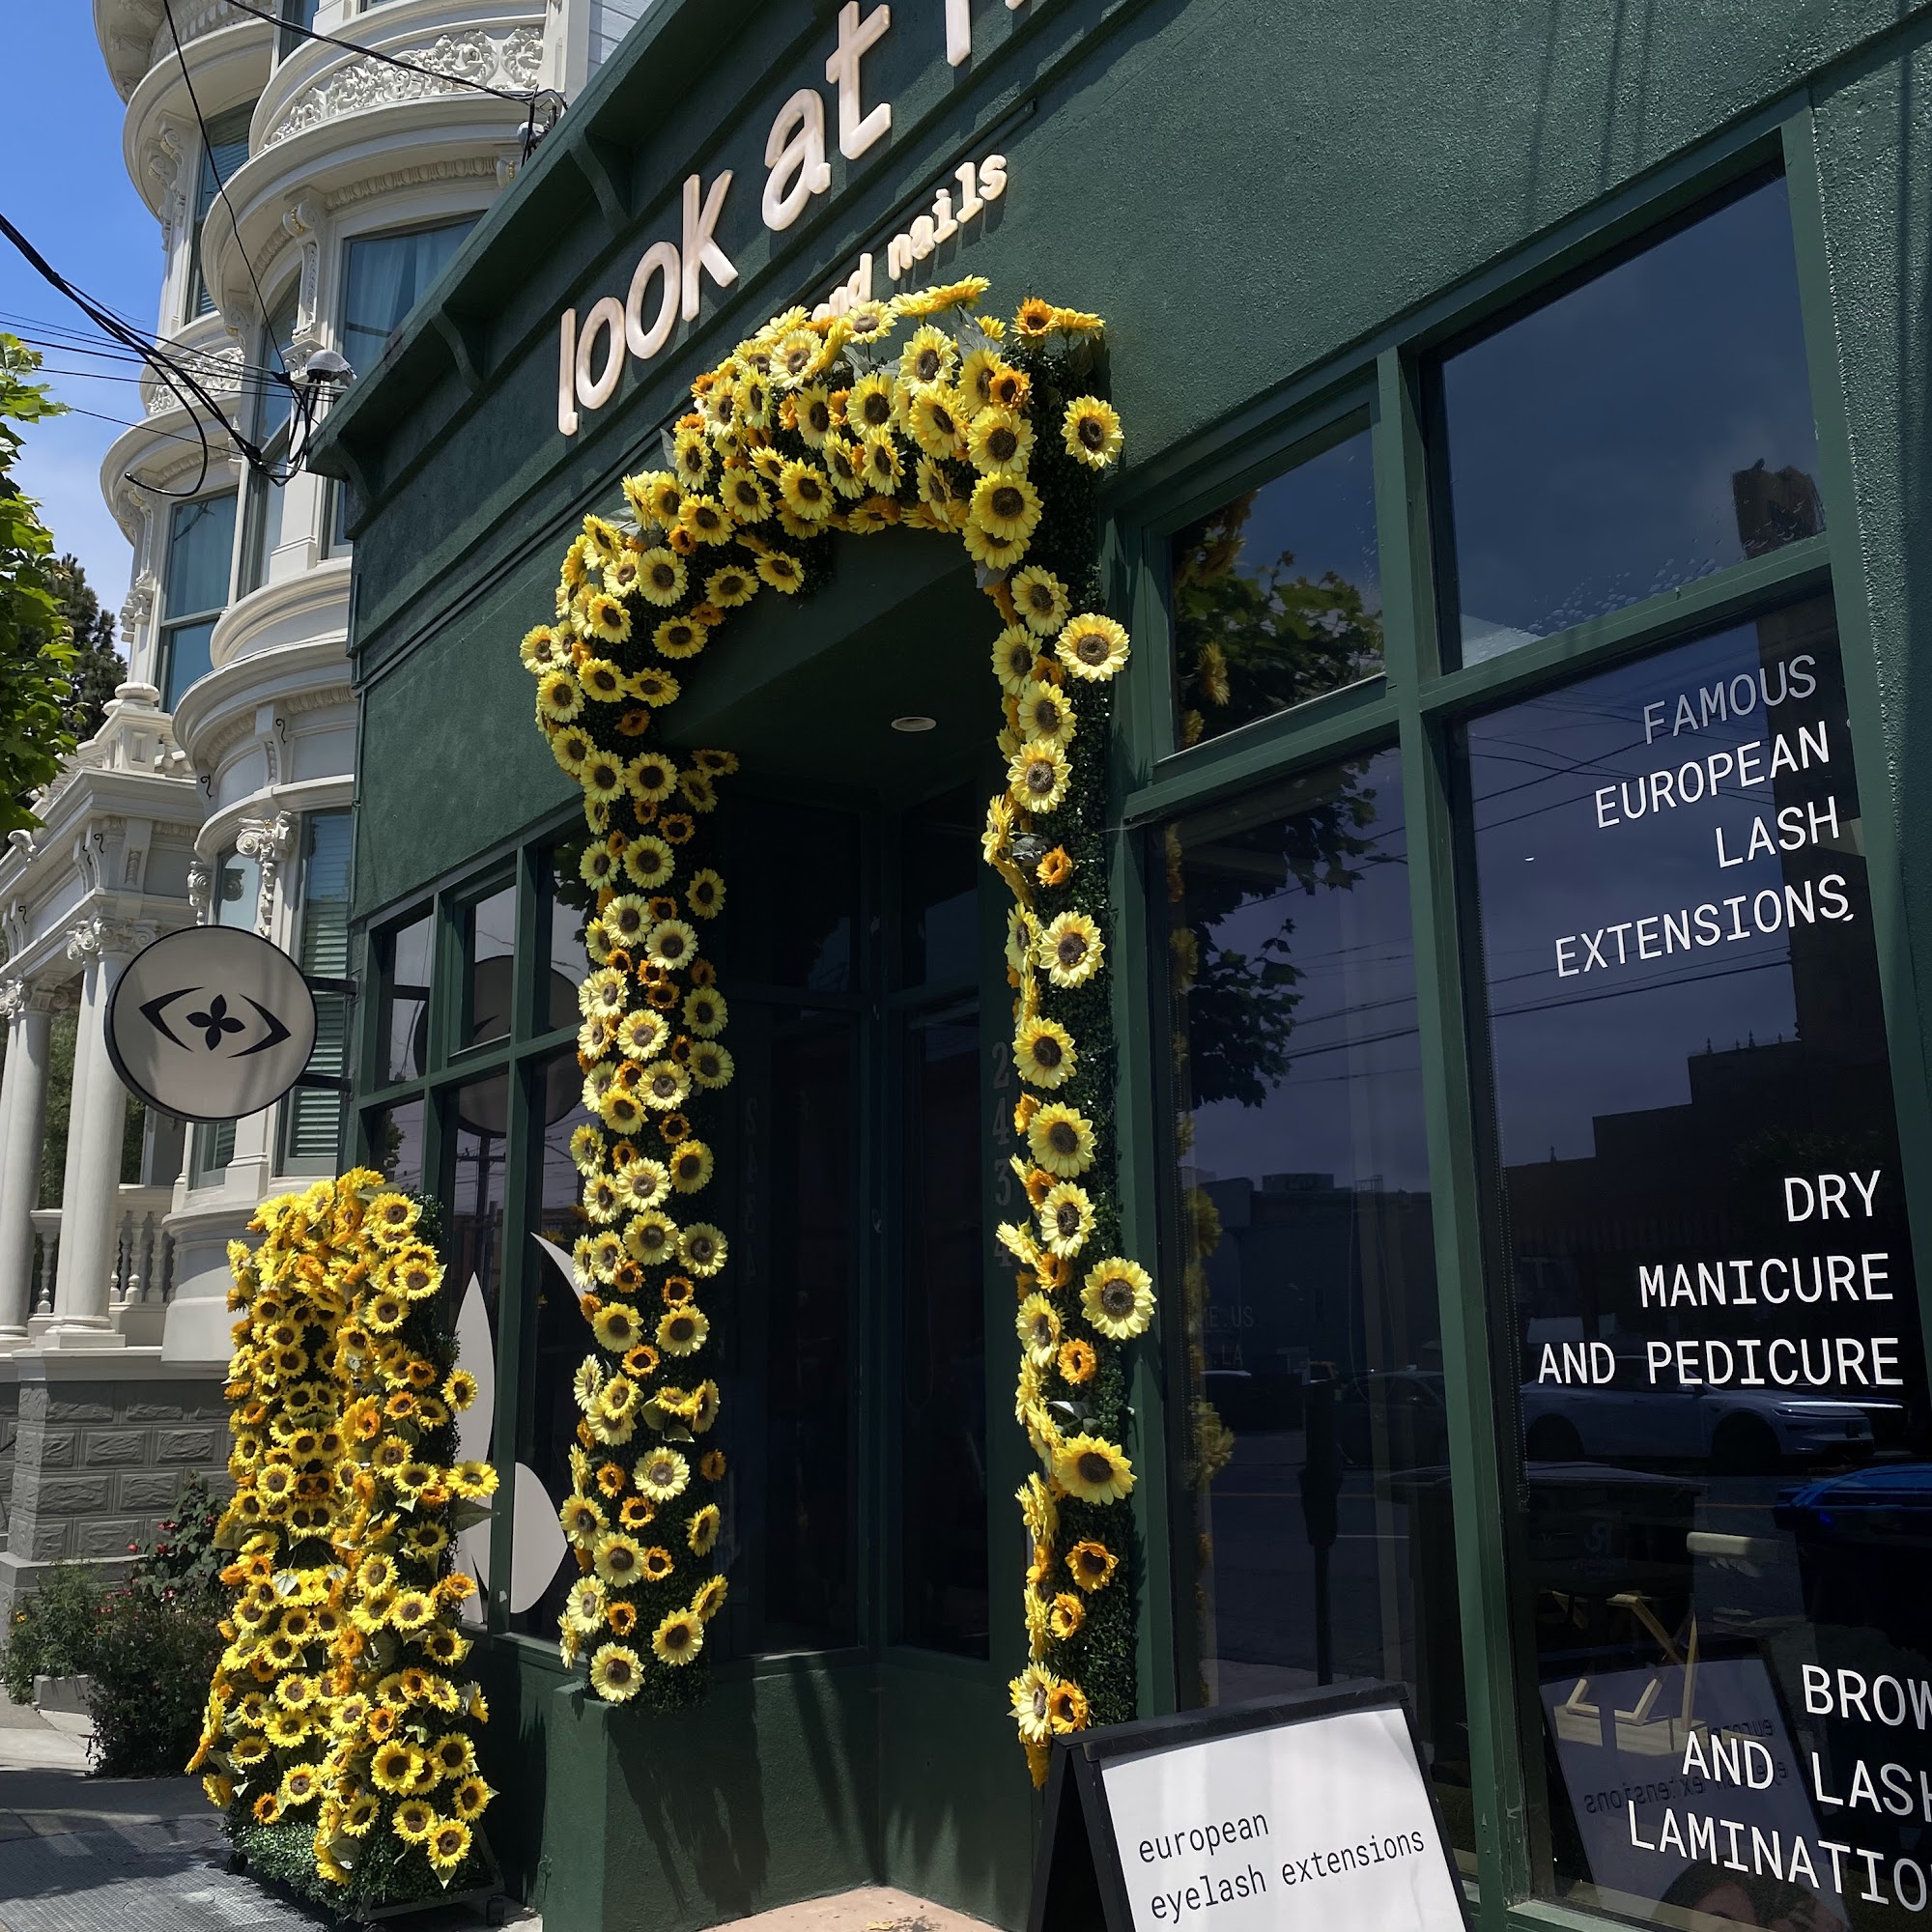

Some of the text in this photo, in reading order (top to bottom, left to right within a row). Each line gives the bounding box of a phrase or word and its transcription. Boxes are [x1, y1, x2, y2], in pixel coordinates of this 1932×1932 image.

[557, 1, 892, 436] look at
[887, 154, 1008, 281] nails
[1643, 654, 1816, 745] FAMOUS
[1595, 720, 1830, 829] EUROPEAN
[1715, 795, 1840, 868] LASH
[1555, 873, 1849, 978] EXTENSIONS
[1784, 1169, 1882, 1222] DRY
[1638, 1252, 1893, 1308] MANICURE
[1538, 1337, 1904, 1385] AND PEDICURE
[1802, 1663, 1932, 1730] BROW
[1682, 1730, 1775, 1790] AND
[1139, 1813, 1269, 1863] european
[1151, 1830, 1425, 1924] eyelash extensions
[1628, 1799, 1932, 1912] LAMINATIO
